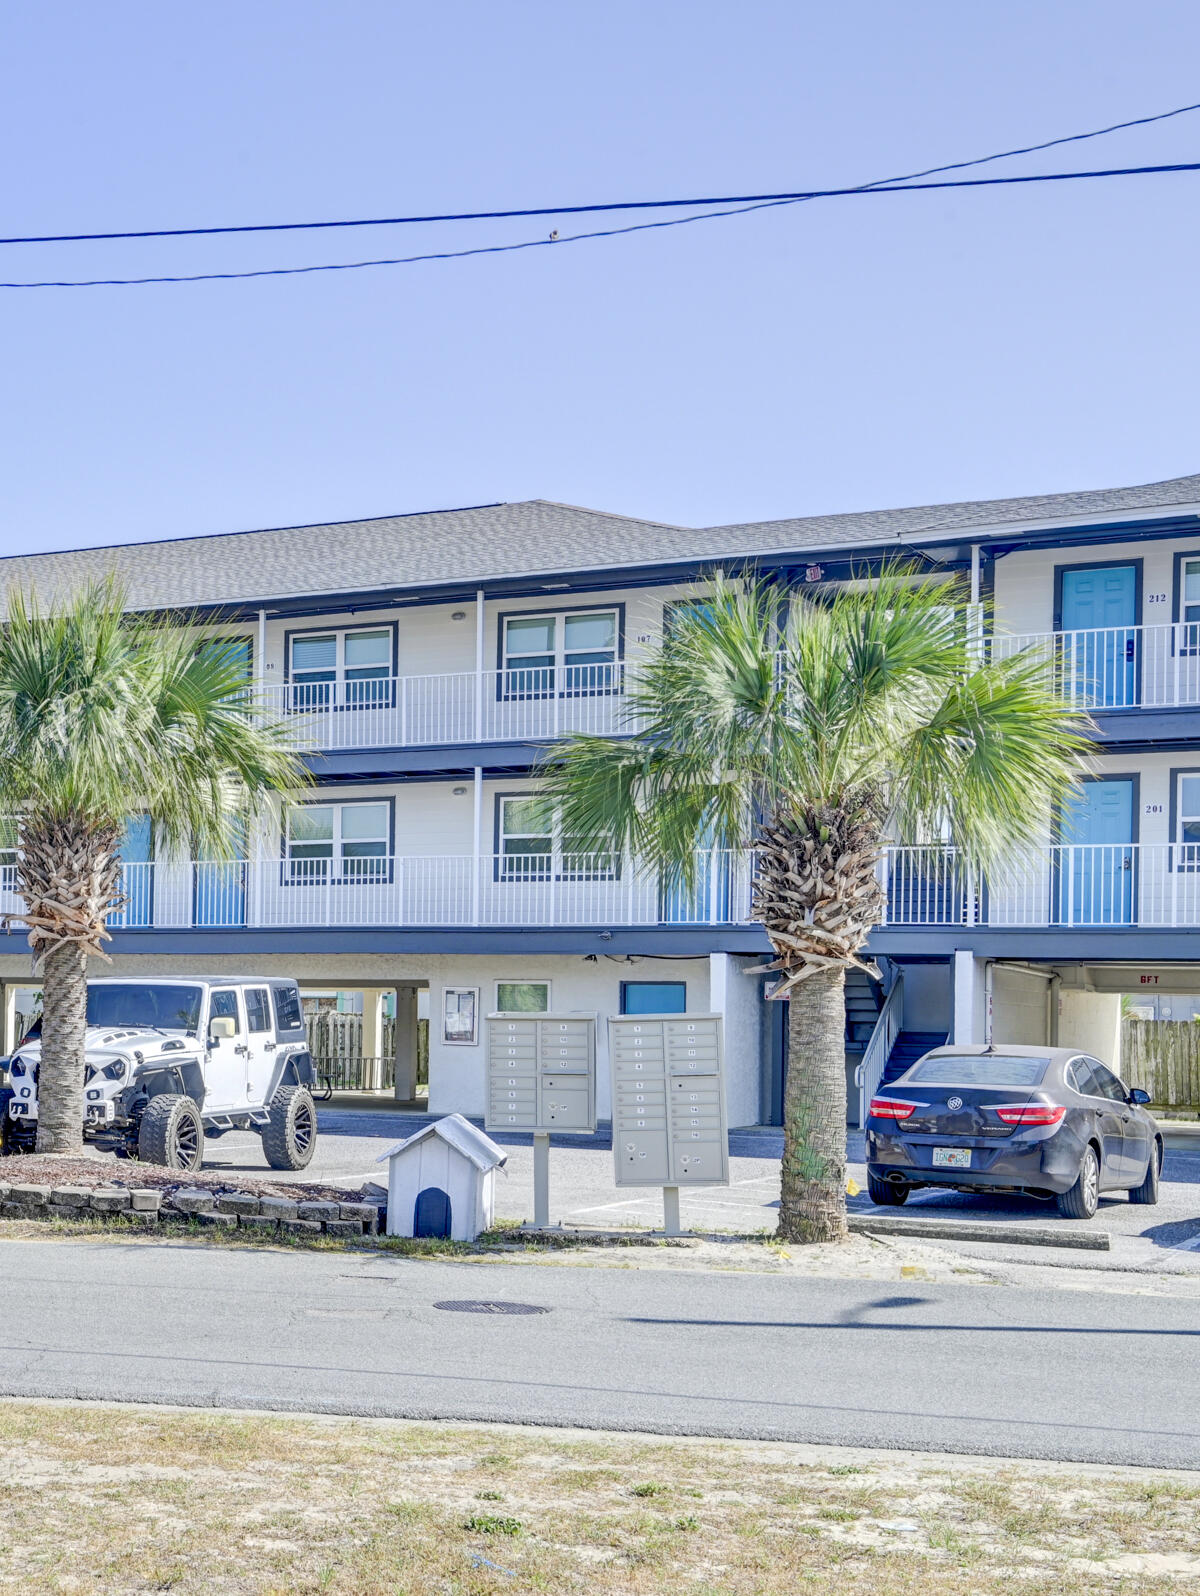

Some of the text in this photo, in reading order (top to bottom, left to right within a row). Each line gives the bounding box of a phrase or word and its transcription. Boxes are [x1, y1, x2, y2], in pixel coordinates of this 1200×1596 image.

[1148, 593, 1166, 603] 212
[637, 635, 651, 643] 107
[1145, 805, 1162, 813] 201
